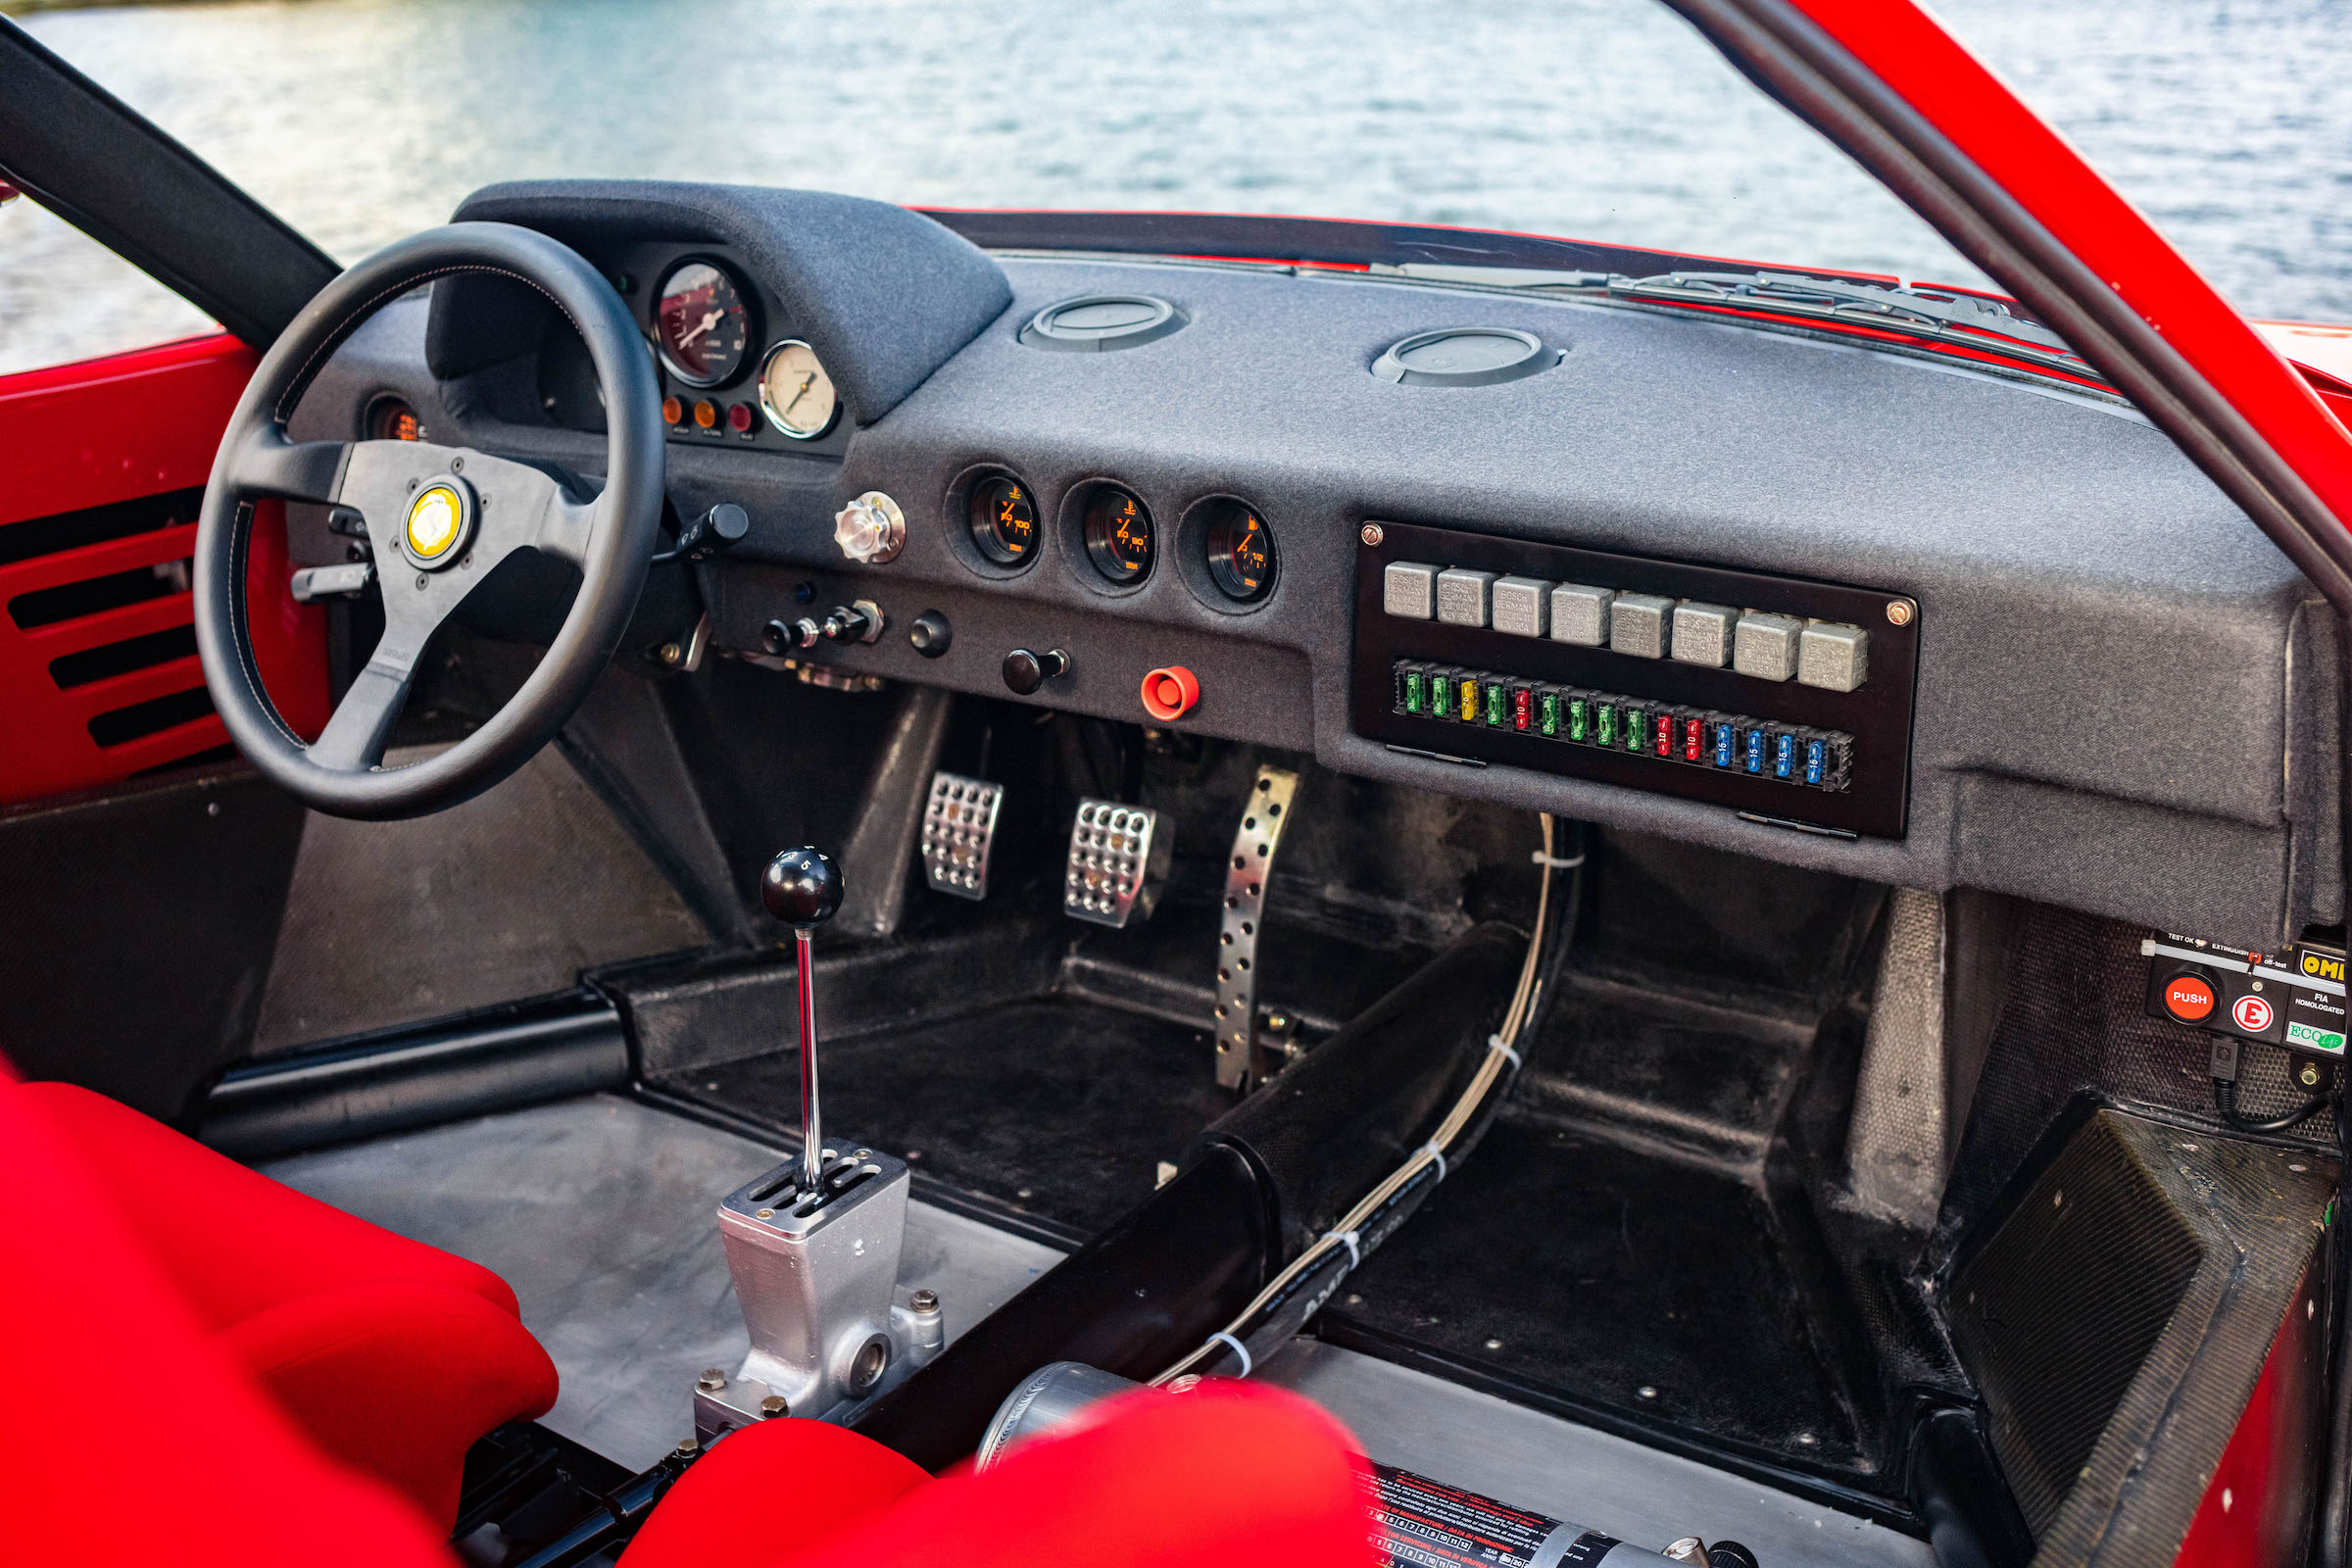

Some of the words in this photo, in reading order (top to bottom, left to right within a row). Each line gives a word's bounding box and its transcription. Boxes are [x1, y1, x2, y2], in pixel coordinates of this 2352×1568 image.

[1501, 590, 1527, 602] BOSCH
[1495, 600, 1532, 612] GERMANY
[1659, 732, 1666, 743] 10
[1688, 736, 1695, 746] 10
[1718, 743, 1727, 753] 15
[1750, 748, 1758, 759] 15
[801, 859, 811, 870] 5
[2264, 958, 2287, 968] off-test
[2174, 992, 2207, 1004] PUSH
[2315, 993, 2328, 1003] FIA
[2295, 999, 2345, 1015] HOMOLOGATED
[2244, 1003, 2262, 1024] E
[2289, 1024, 2323, 1042] ECO
[2322, 1036, 2339, 1046] Life
[1379, 1482, 1396, 1491] return
[1373, 1492, 1388, 1501] Dopo
[1399, 1500, 1423, 1512] restituire
[1485, 1530, 1514, 1544] autorizzato
[1380, 1490, 1397, 1498] essere
[1397, 1494, 1425, 1507] controllato
[1477, 1522, 1500, 1534] risponde
[1506, 1531, 1533, 1544] eventuali
[1397, 1509, 1444, 1529] MANUFACTURE
[1446, 1526, 1465, 1537] DATA
[1400, 1485, 1423, 1495] serviced
[1514, 1523, 1539, 1534] damages
[1572, 1543, 1590, 1551] wrong
[1387, 1530, 1399, 1540] FOR
[1398, 1535, 1432, 1551] SERVICING
[1435, 1546, 1452, 1557] DATA
[1458, 1555, 1488, 1568] VERIFICA
[1484, 1546, 1497, 1555] YEAR
[1480, 1551, 1496, 1561] ANNO
